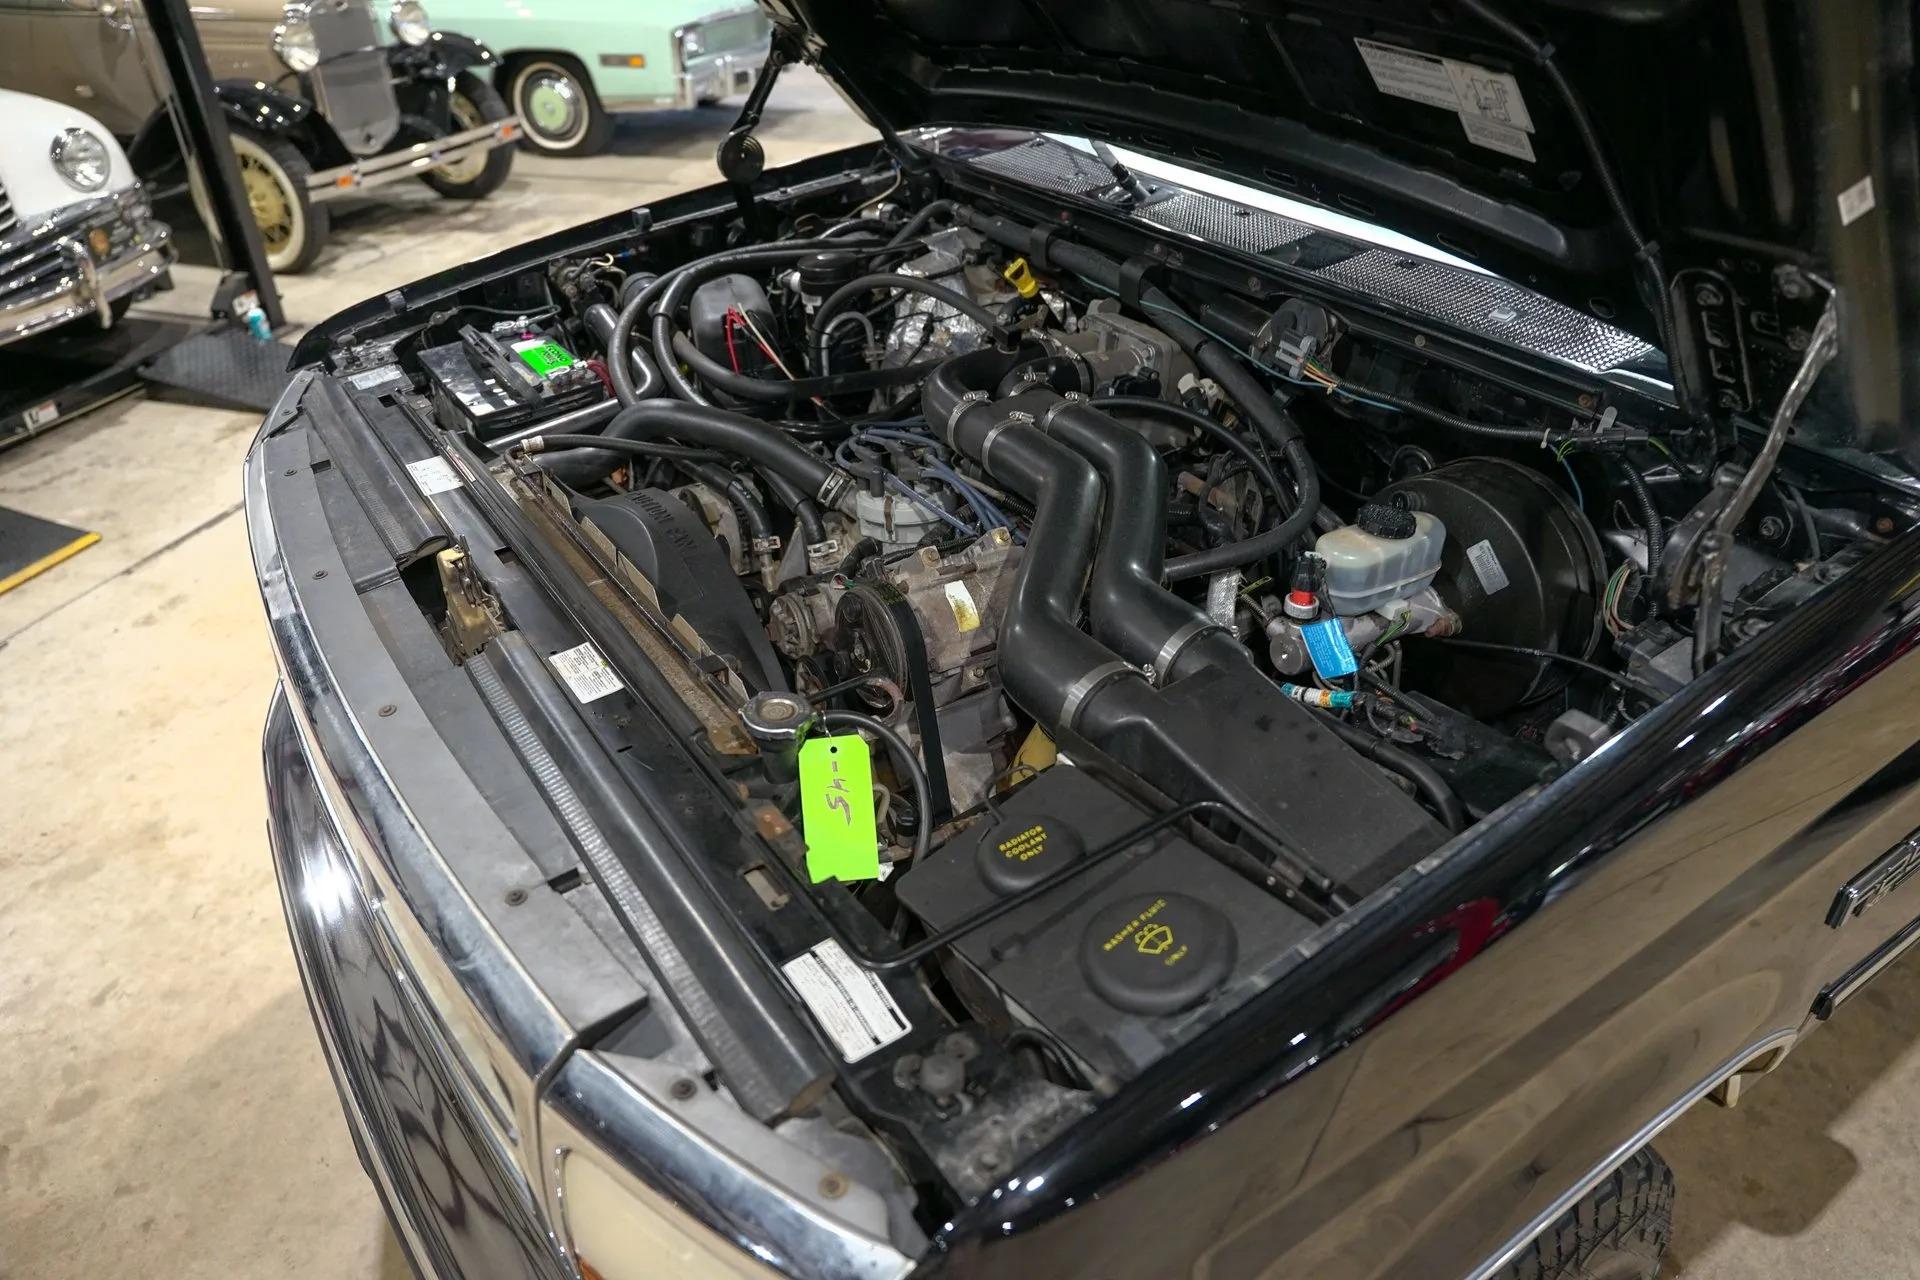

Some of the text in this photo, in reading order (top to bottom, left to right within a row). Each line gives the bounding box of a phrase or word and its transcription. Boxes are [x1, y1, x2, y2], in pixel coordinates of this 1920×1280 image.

[999, 825, 1042, 852] RADIATOR
[1005, 832, 1048, 858] COOLANT
[1020, 844, 1043, 861] ONLY
